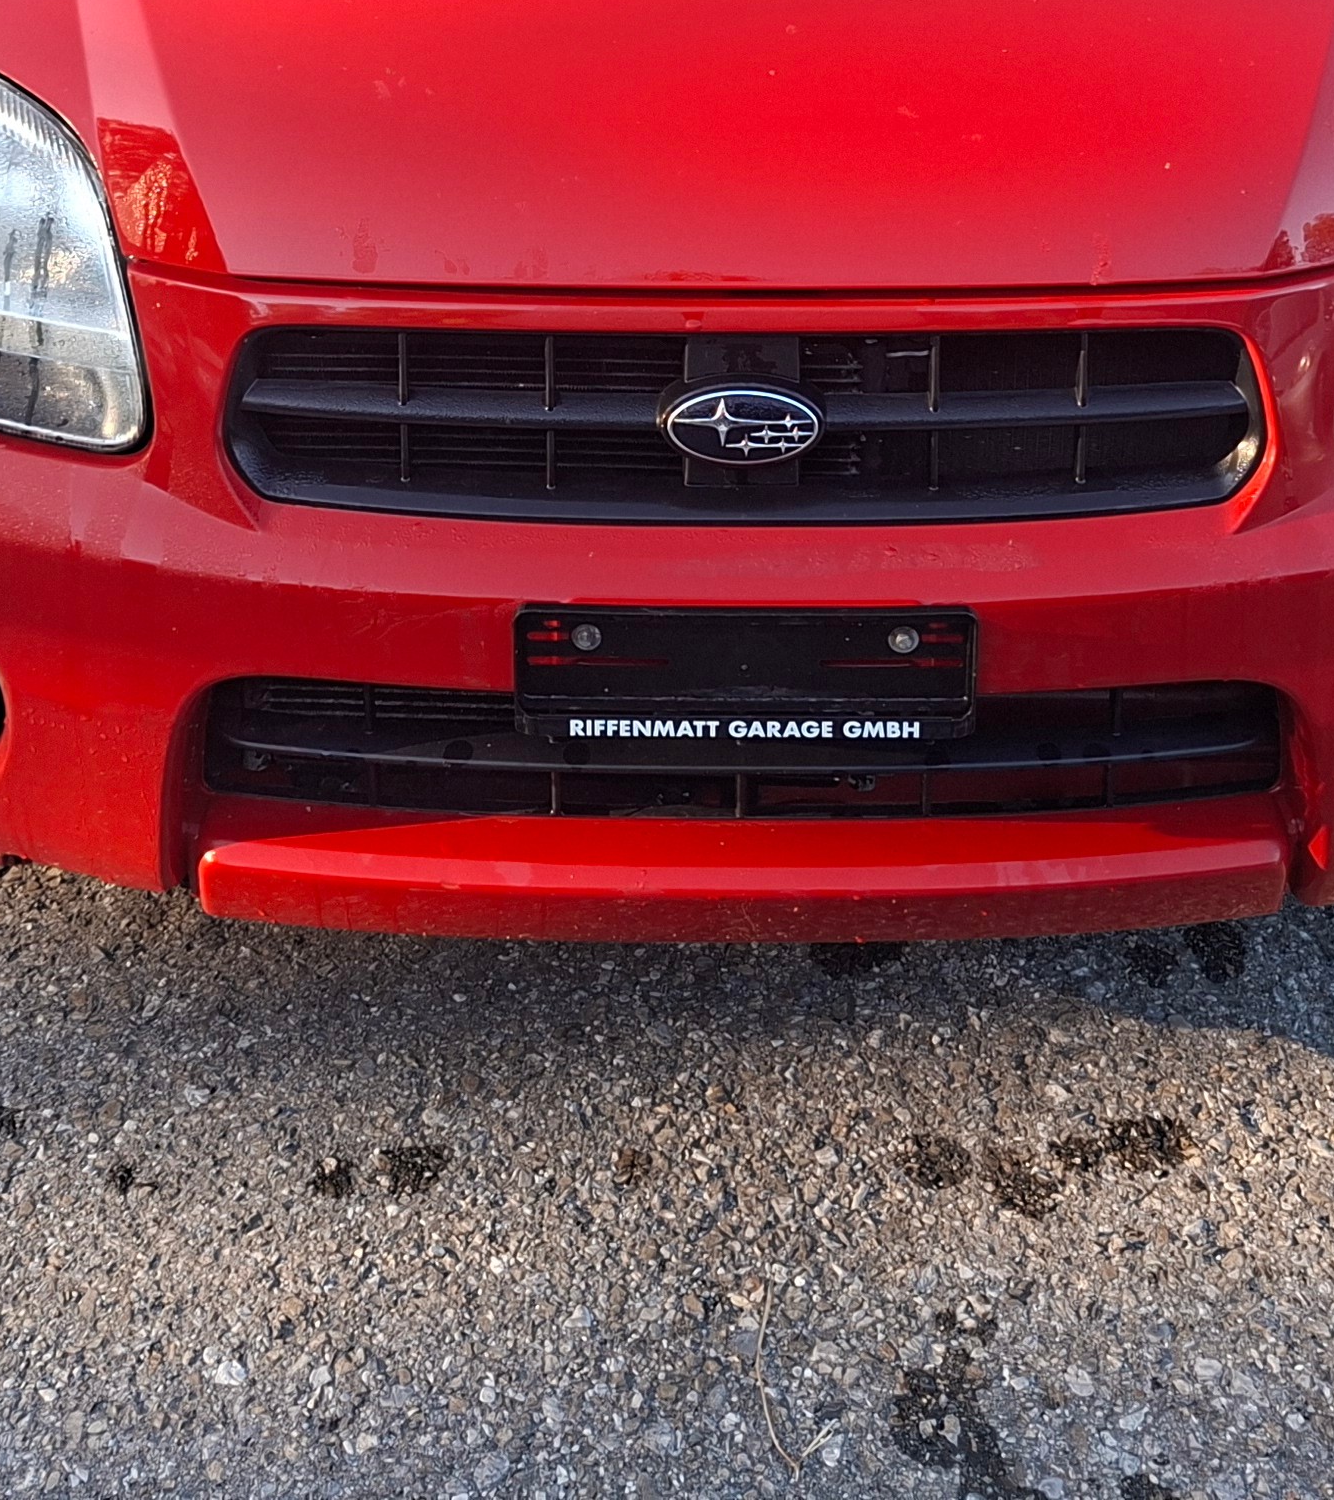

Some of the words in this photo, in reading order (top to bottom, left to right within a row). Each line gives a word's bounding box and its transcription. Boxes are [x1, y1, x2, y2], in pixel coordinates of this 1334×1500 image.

[569, 719, 720, 738] RIFFENMATT
[728, 720, 833, 738] GARAGE
[842, 720, 920, 739] GMBH
